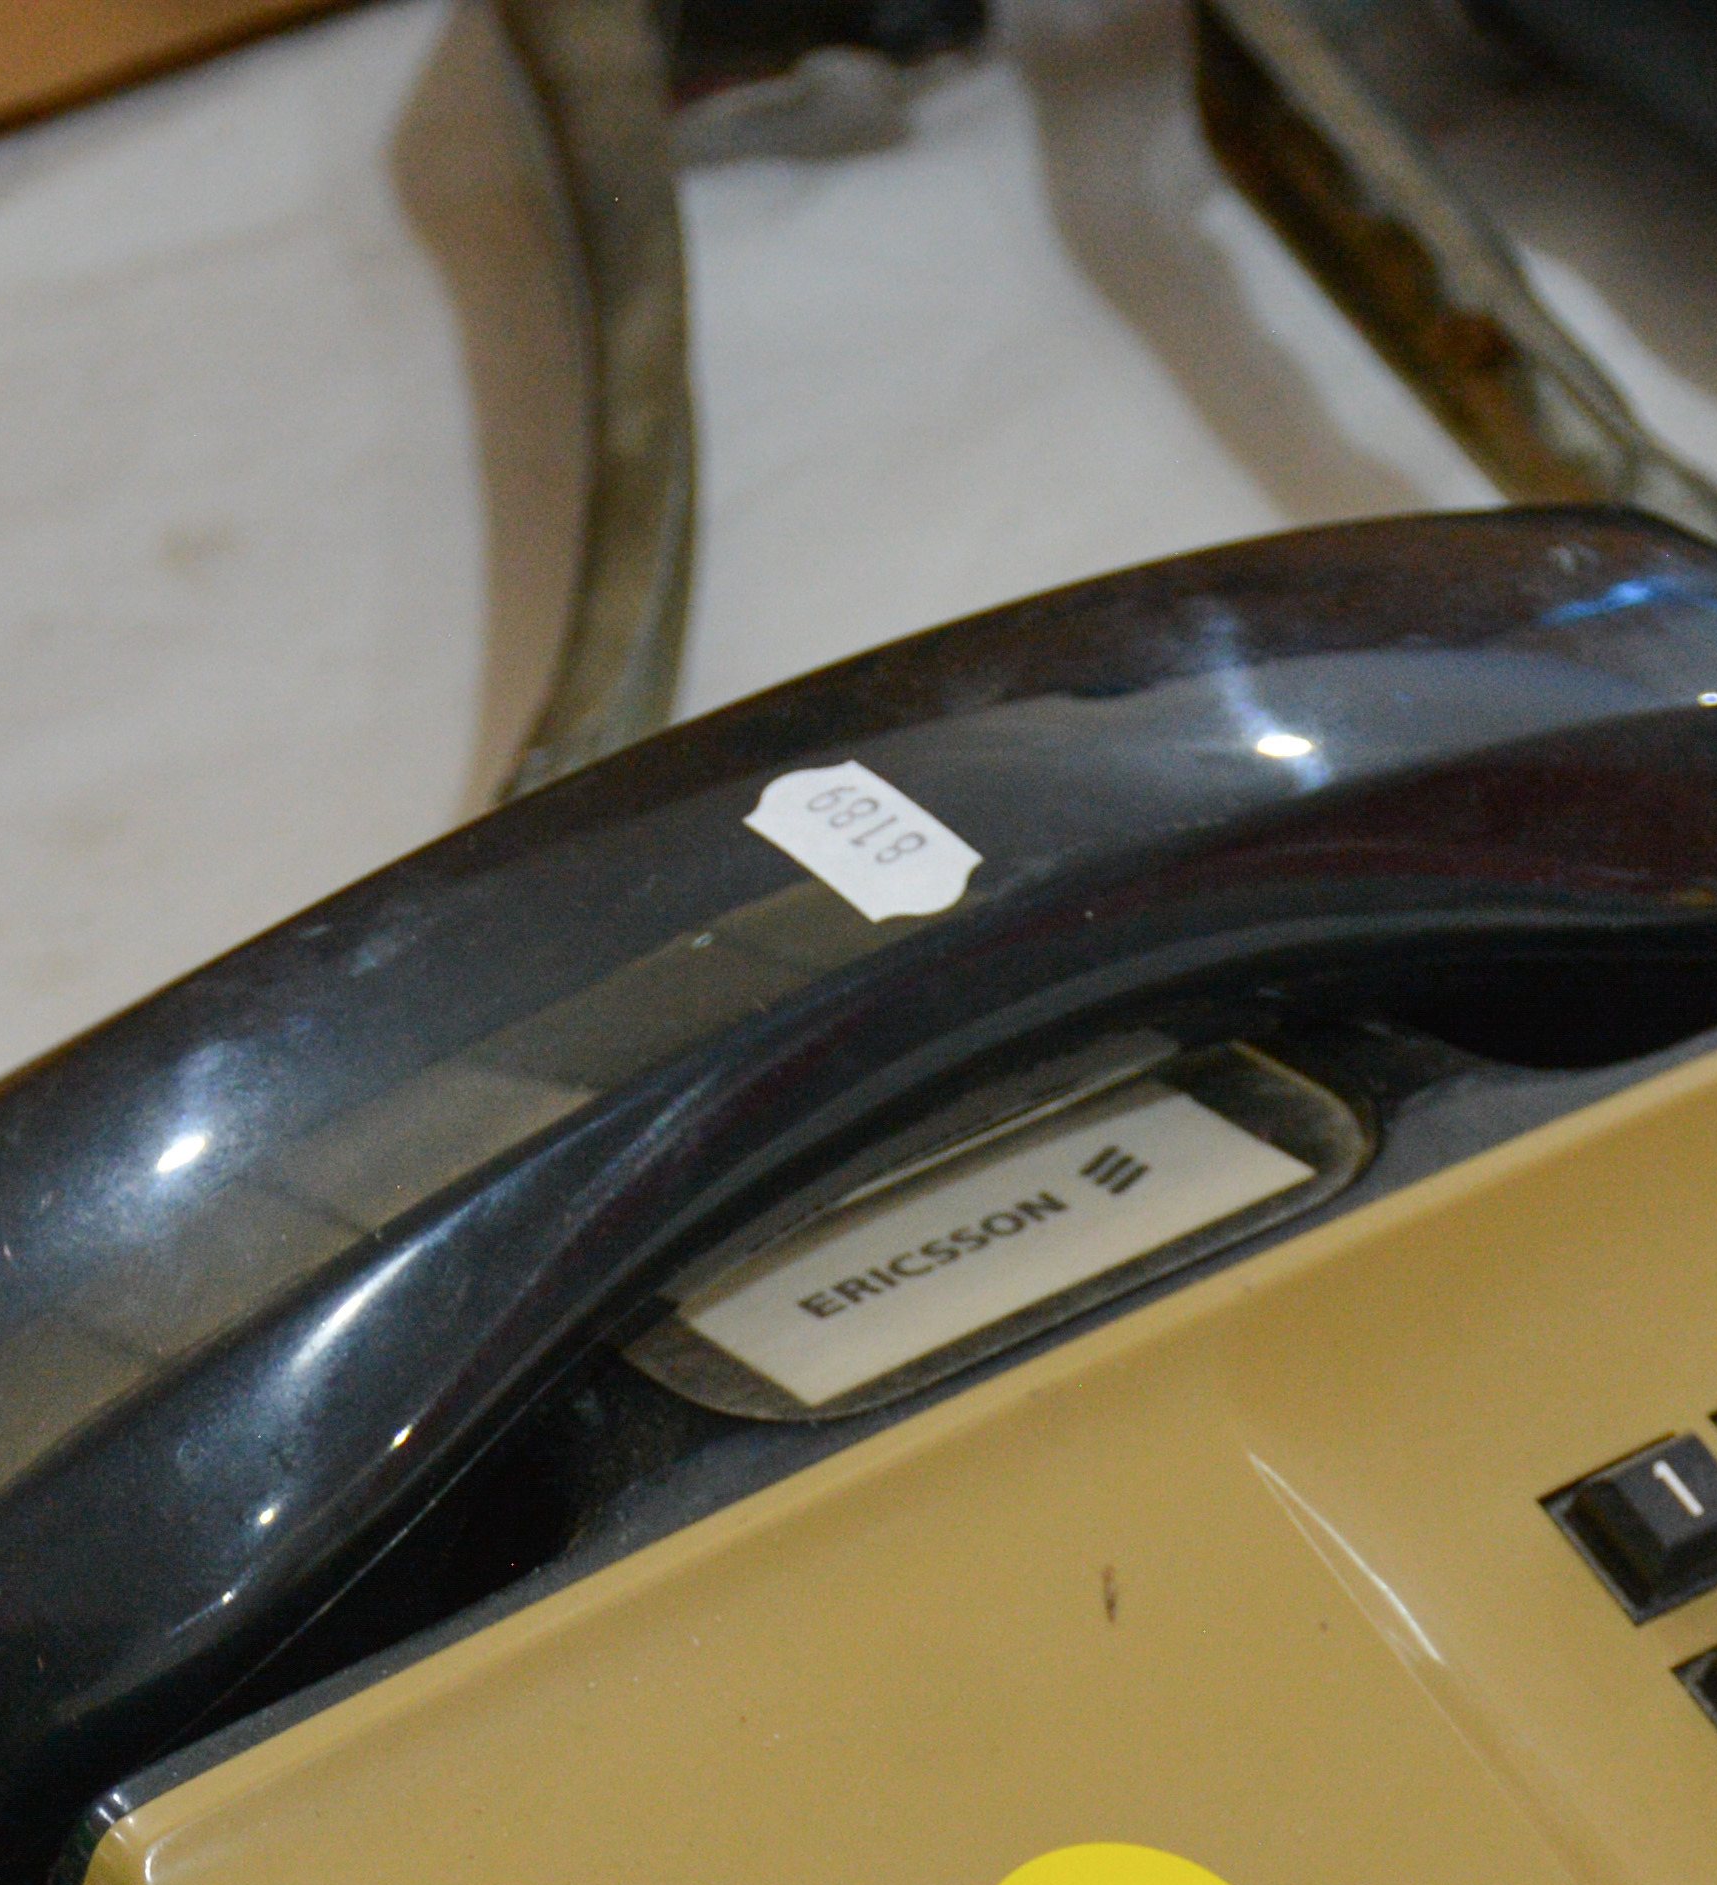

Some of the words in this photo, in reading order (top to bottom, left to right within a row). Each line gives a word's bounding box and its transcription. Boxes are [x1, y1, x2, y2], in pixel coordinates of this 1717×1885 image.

[806, 784, 927, 866] 8189
[796, 1191, 1069, 1321] ERICSSON
[1652, 1460, 1704, 1516] 1
